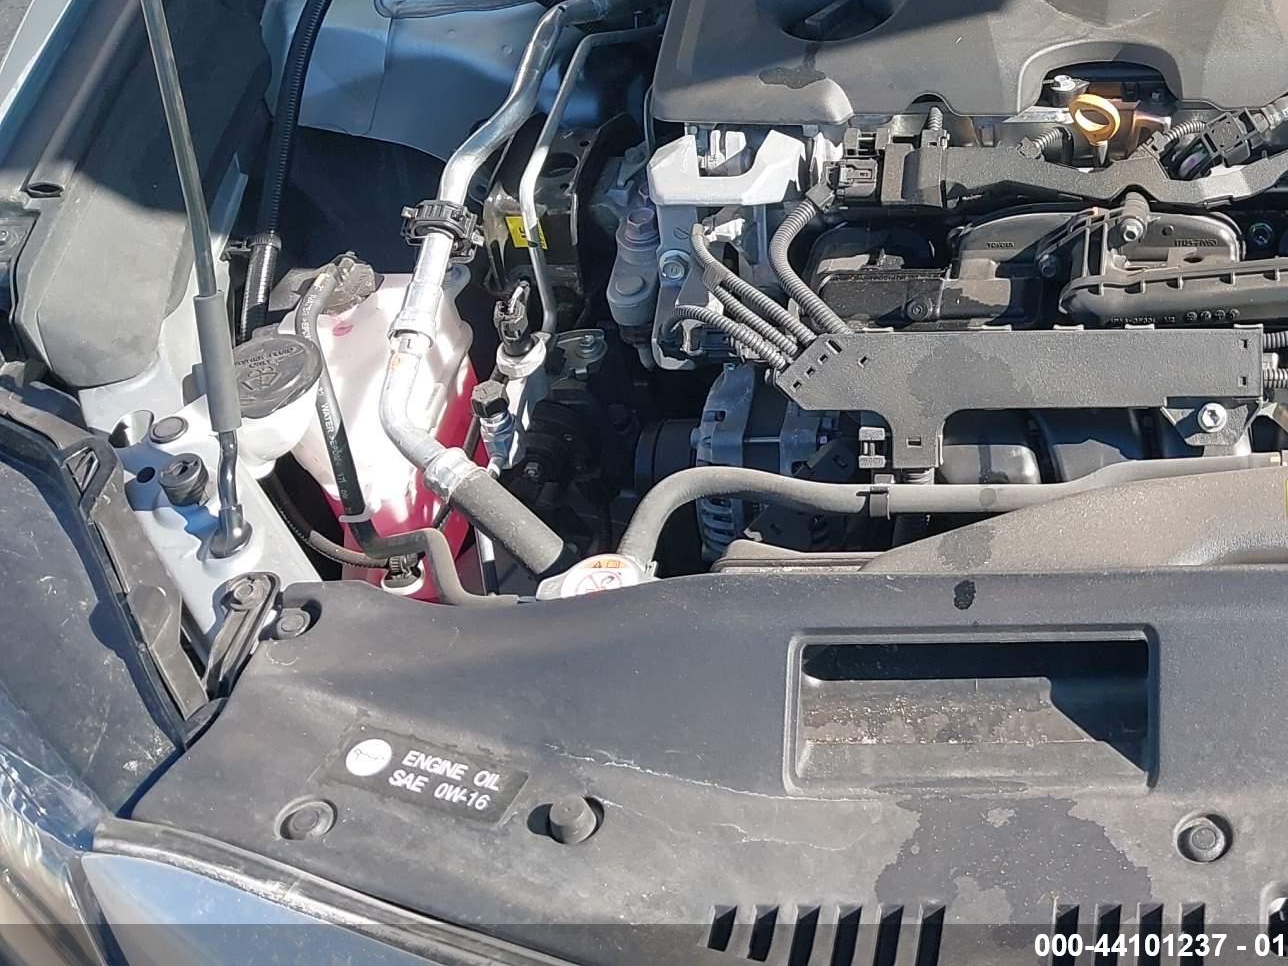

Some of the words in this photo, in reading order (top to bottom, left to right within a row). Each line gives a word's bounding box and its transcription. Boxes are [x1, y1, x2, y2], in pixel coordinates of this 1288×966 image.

[321, 402, 335, 434] WATER
[389, 770, 429, 793] SAE
[434, 783, 491, 810] 0W-16
[402, 750, 468, 781] ENGINE
[474, 770, 501, 791] OIL
